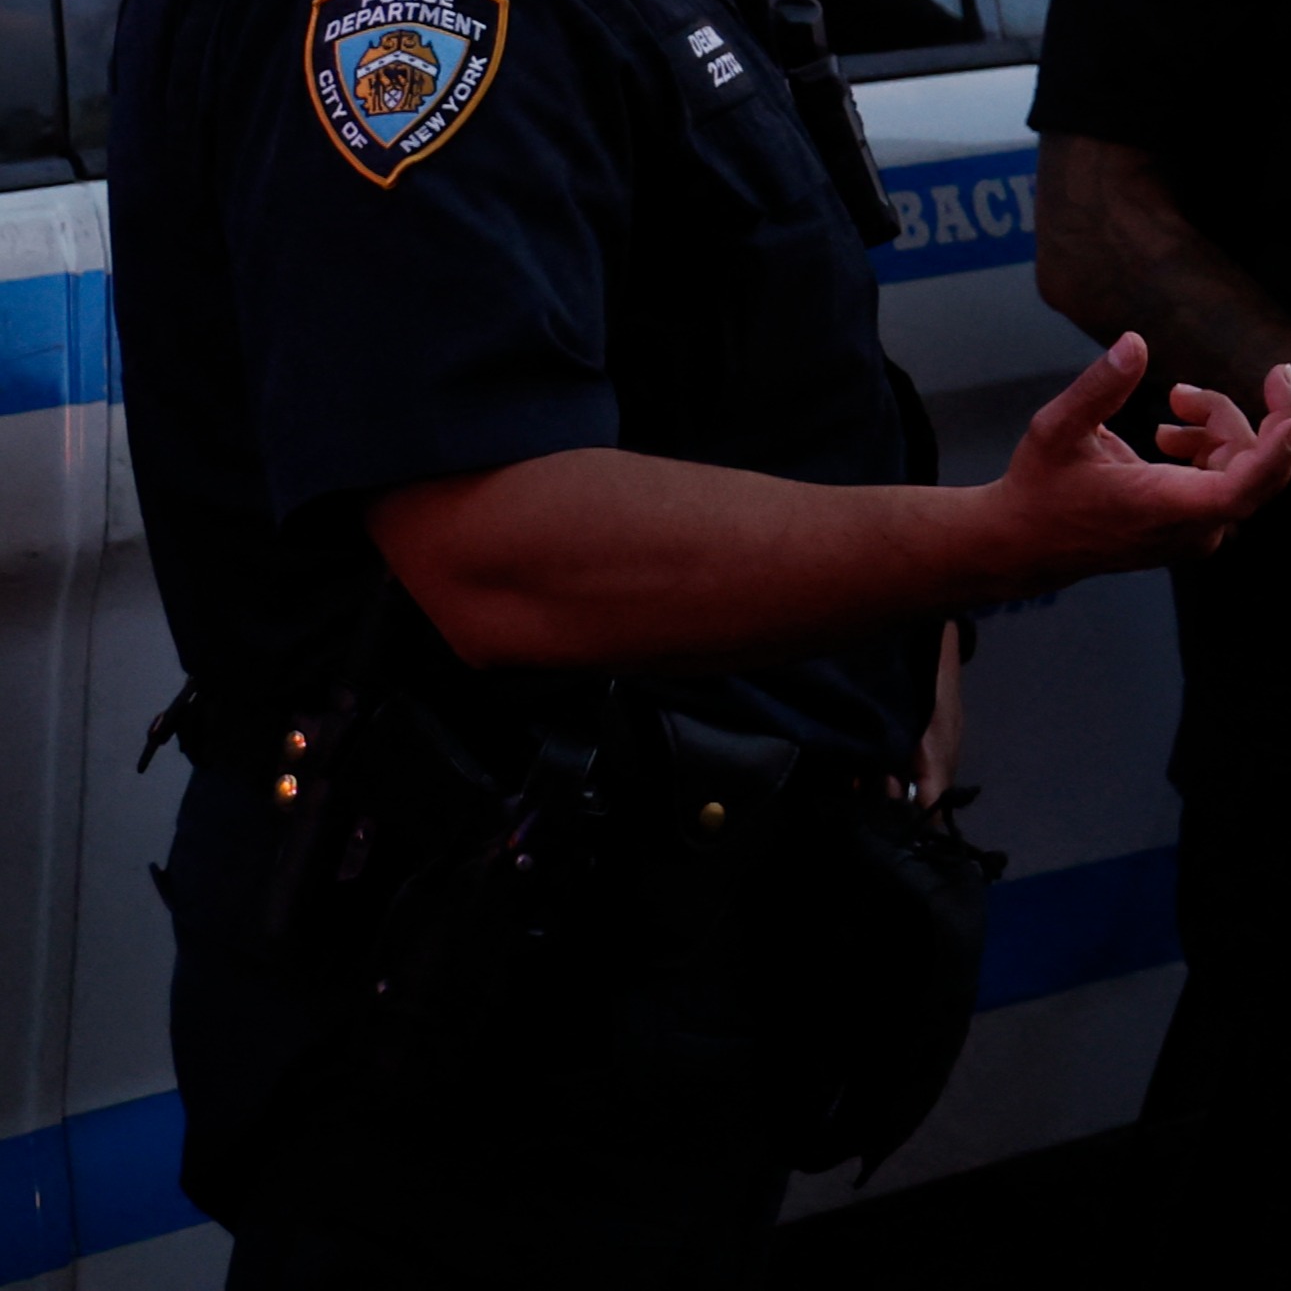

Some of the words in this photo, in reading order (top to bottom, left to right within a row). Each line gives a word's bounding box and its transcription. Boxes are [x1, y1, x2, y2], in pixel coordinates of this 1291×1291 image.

[324, 2, 488, 43] DEPARTMENT
[318, 69, 347, 119] CITY
[341, 121, 368, 149] OF
[400, 111, 446, 153] NEW
[442, 55, 488, 114] YORK
